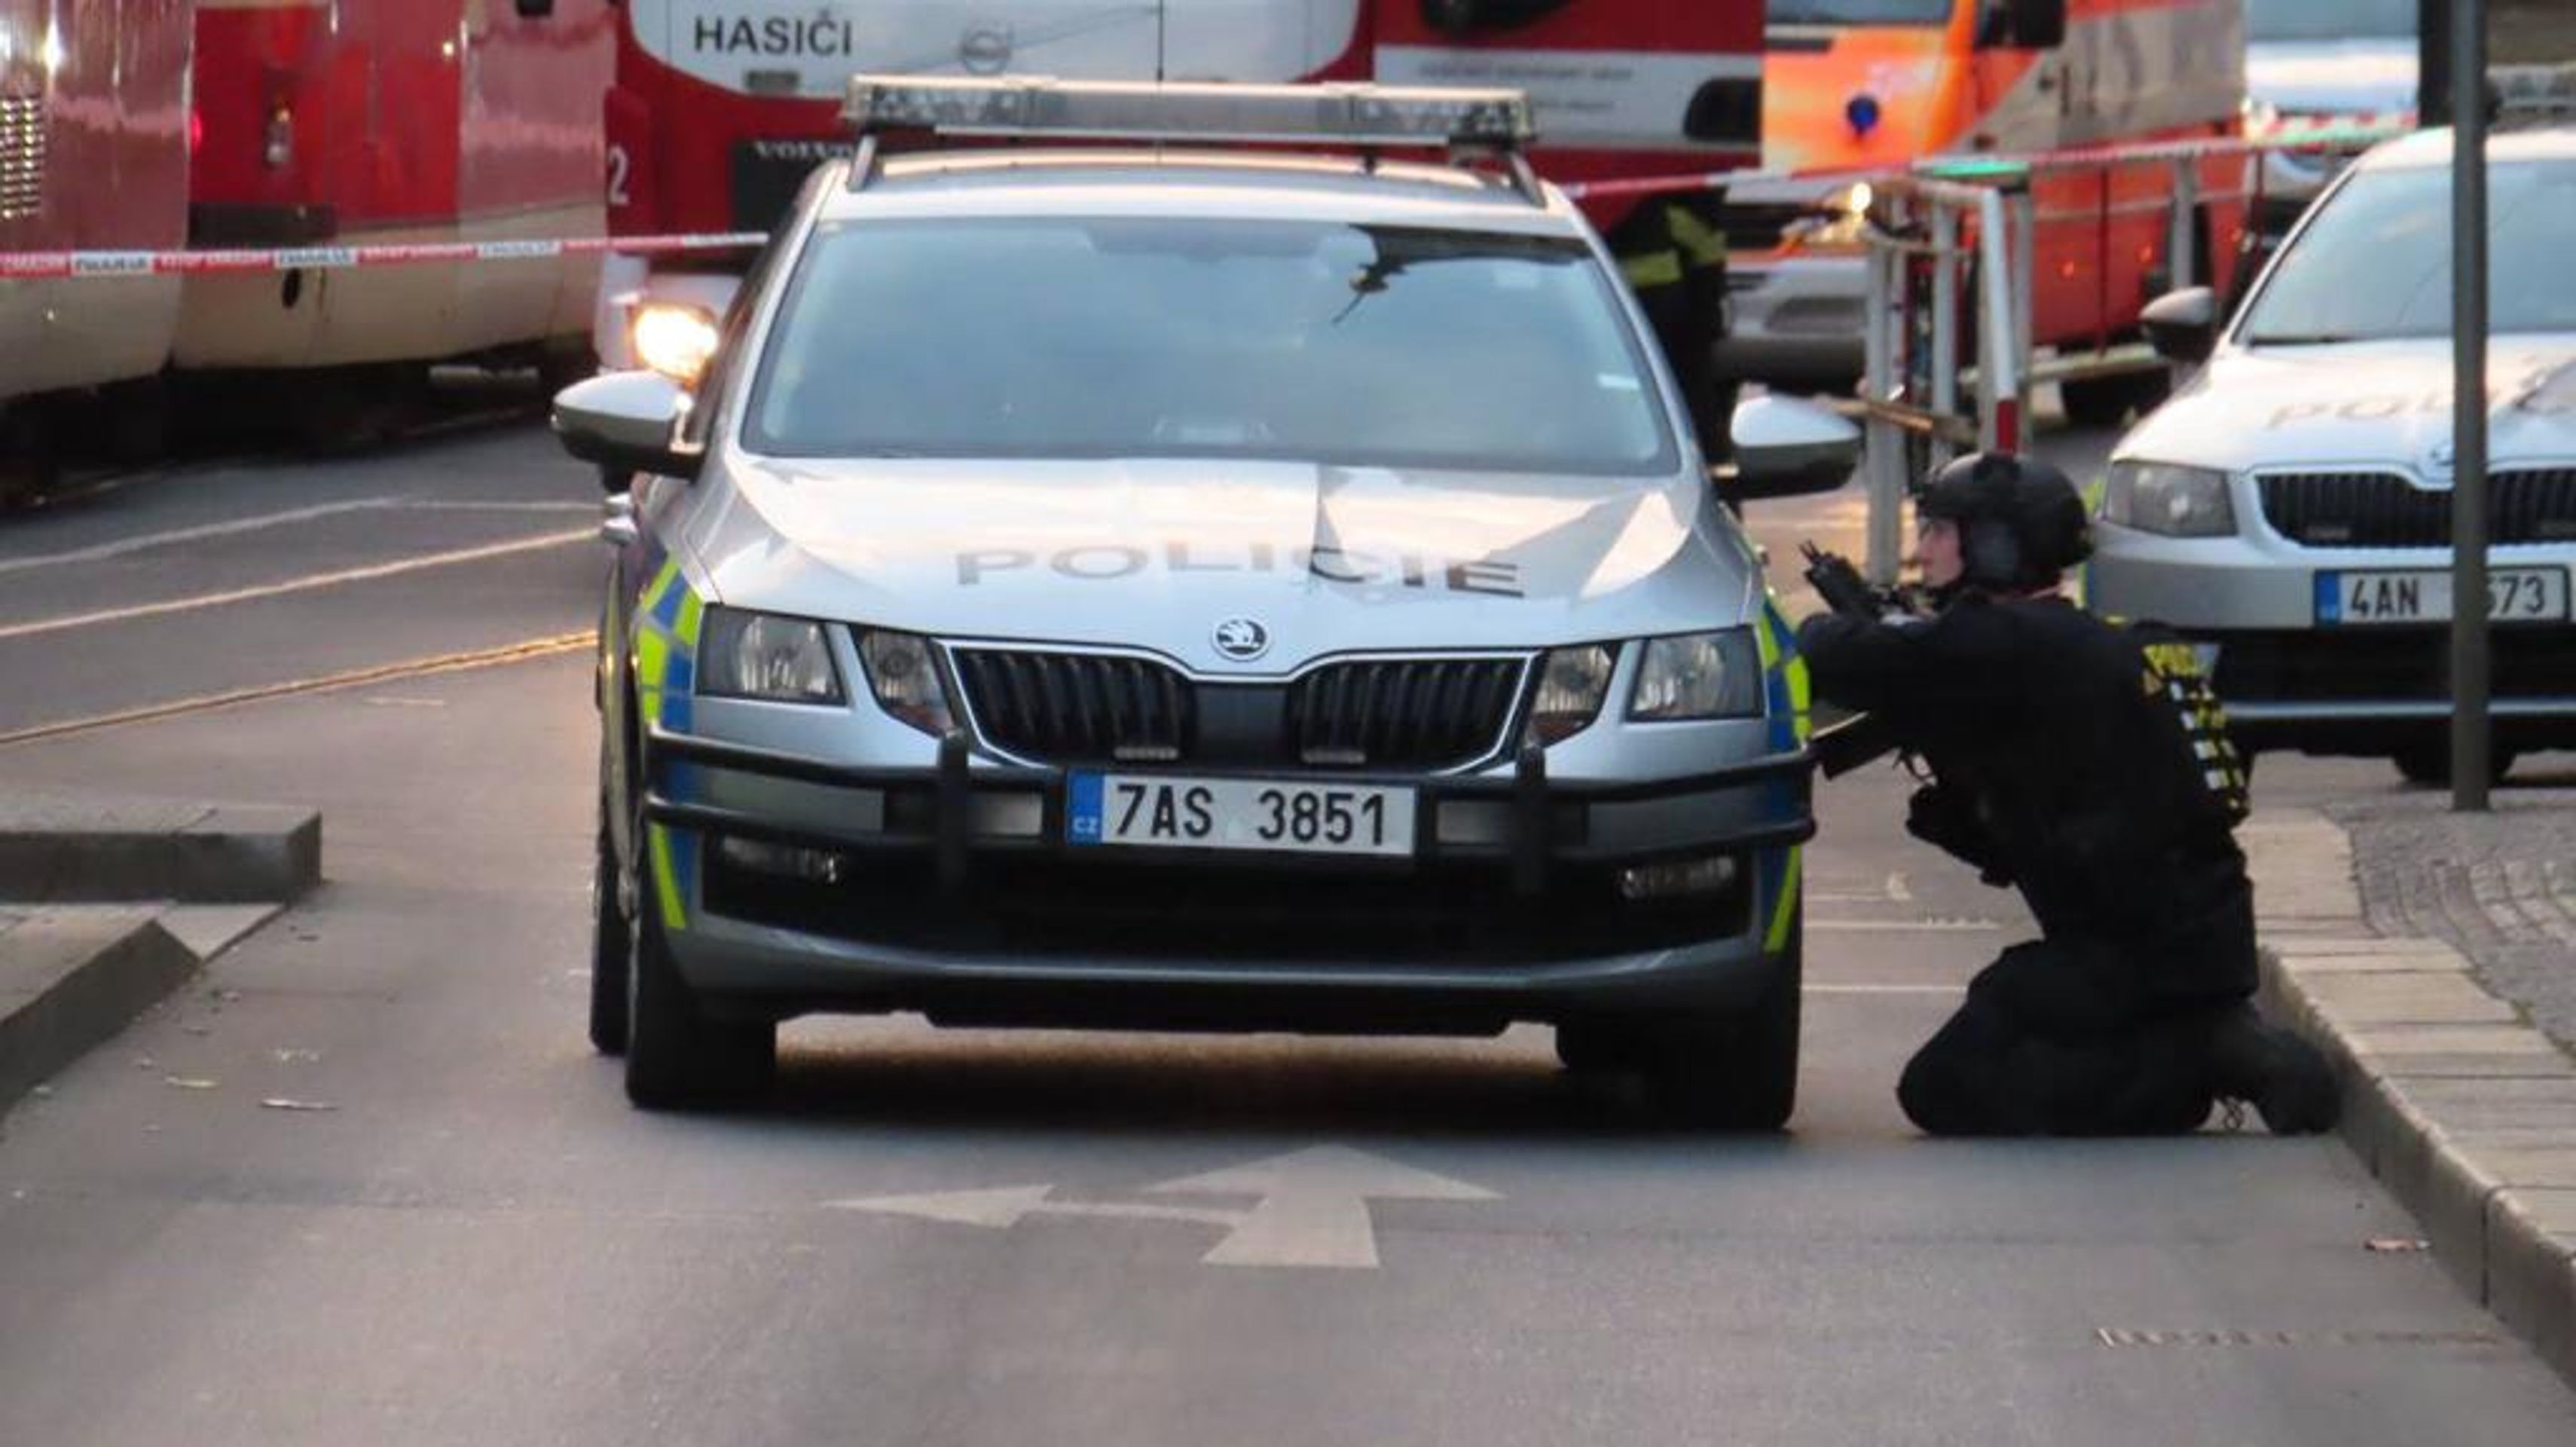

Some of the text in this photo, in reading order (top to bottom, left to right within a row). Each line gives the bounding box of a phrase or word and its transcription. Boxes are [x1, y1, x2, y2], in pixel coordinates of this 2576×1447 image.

[693, 9, 851, 56] HASIČI
[956, 541, 1525, 598] POLICIE
[2351, 578, 2420, 616] 4AN
[1073, 818, 1098, 834] CZ
[1116, 785, 1385, 846] 7AS 3851
